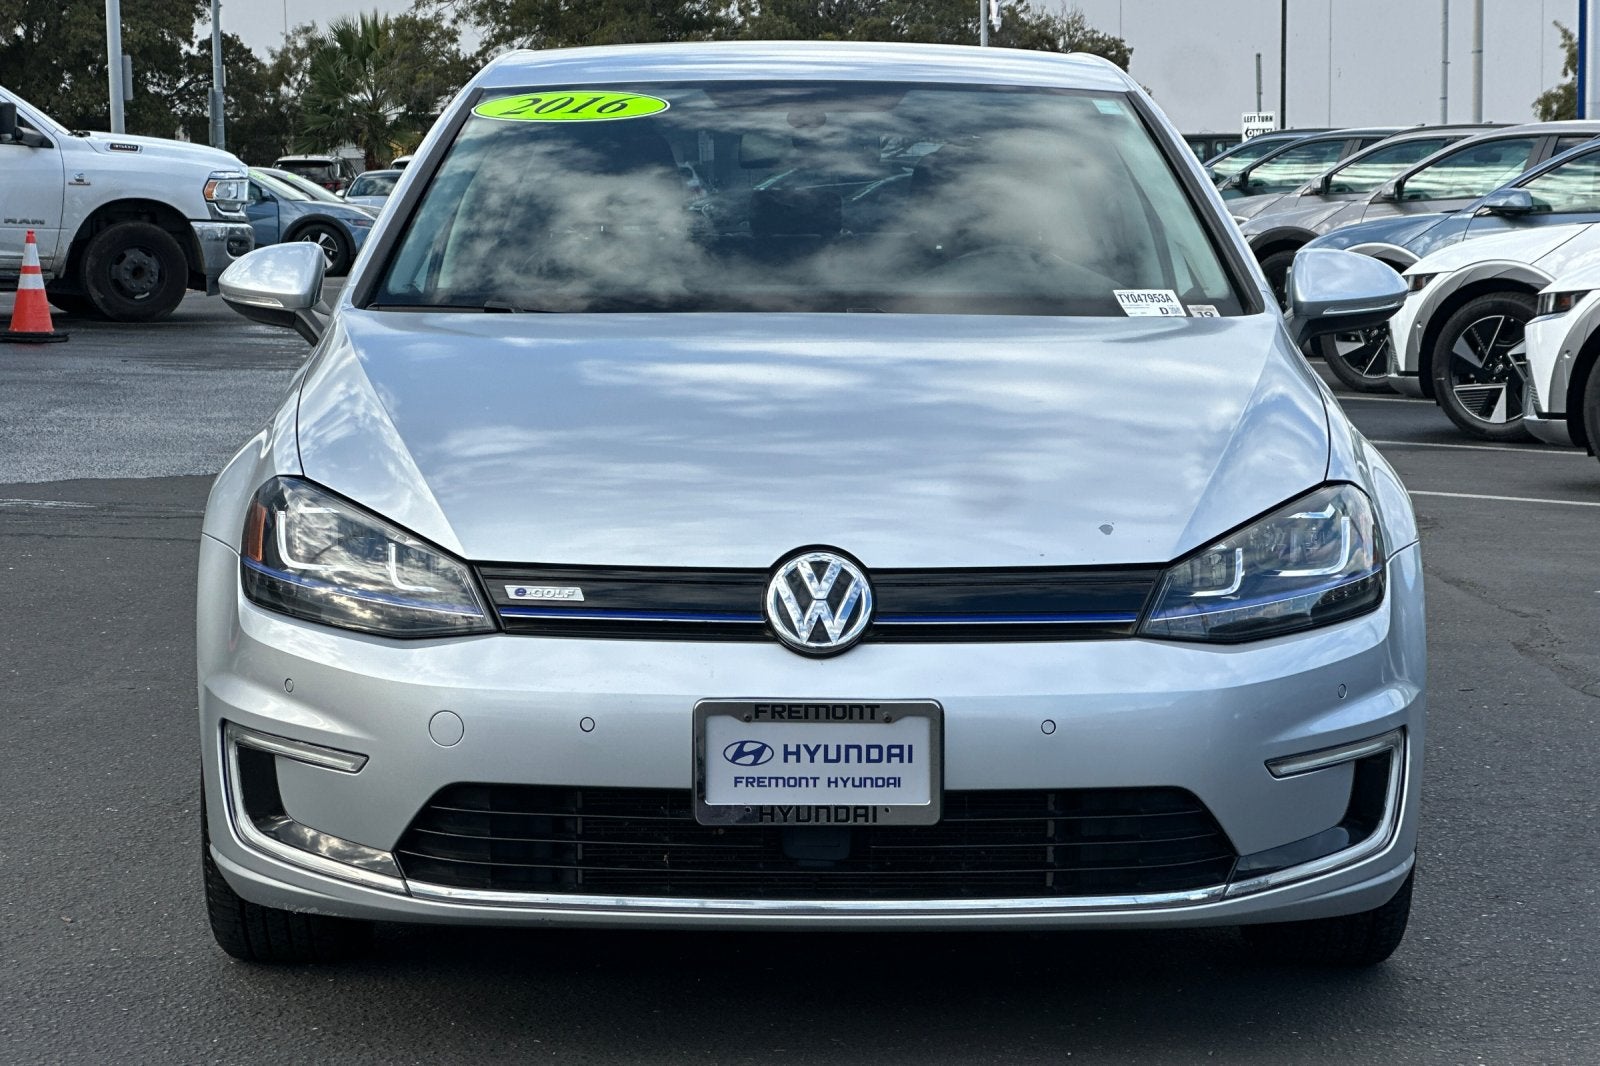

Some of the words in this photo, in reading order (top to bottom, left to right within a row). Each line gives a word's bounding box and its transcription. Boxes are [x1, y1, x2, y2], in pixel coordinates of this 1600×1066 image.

[498, 96, 639, 115] 2016
[1243, 115, 1256, 123] LEFT
[1257, 115, 1273, 123] TURN
[1117, 293, 1174, 303] TY047953A
[754, 704, 880, 720] FREMONT
[783, 744, 913, 763] HYUNDAI
[734, 776, 820, 788] FREMONT
[827, 776, 901, 788] HYUNDAI
[758, 805, 878, 823] HYUNDAI
